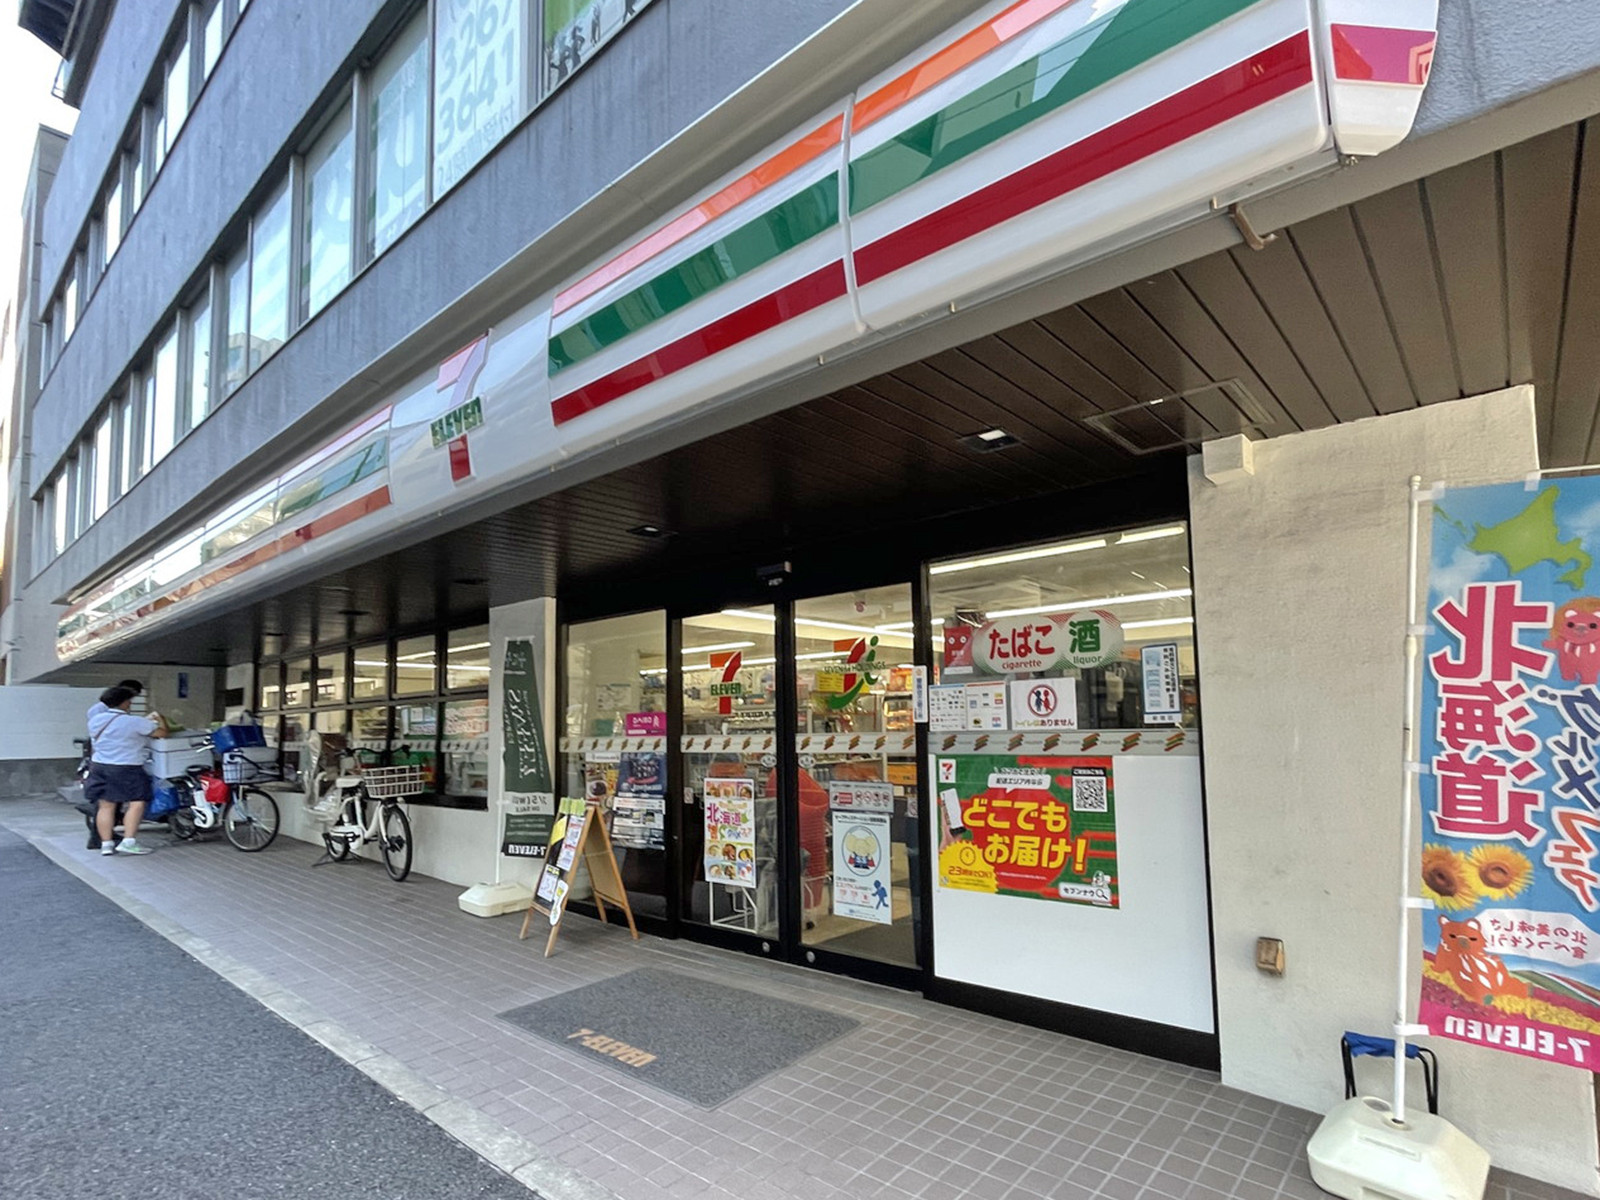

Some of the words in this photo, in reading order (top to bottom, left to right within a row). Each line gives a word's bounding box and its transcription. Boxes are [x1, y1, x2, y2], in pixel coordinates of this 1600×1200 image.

[438, 29, 515, 154] 3641
[988, 623, 1056, 660] たばこ
[1068, 618, 1101, 654] 酒
[1001, 658, 1043, 670] cigarette
[1072, 655, 1102, 666] liquor
[1015, 718, 1075, 727] トイレはありません
[706, 802, 742, 827] 北海道
[962, 797, 1067, 833] どこでも
[984, 833, 1088, 871] お届け!
